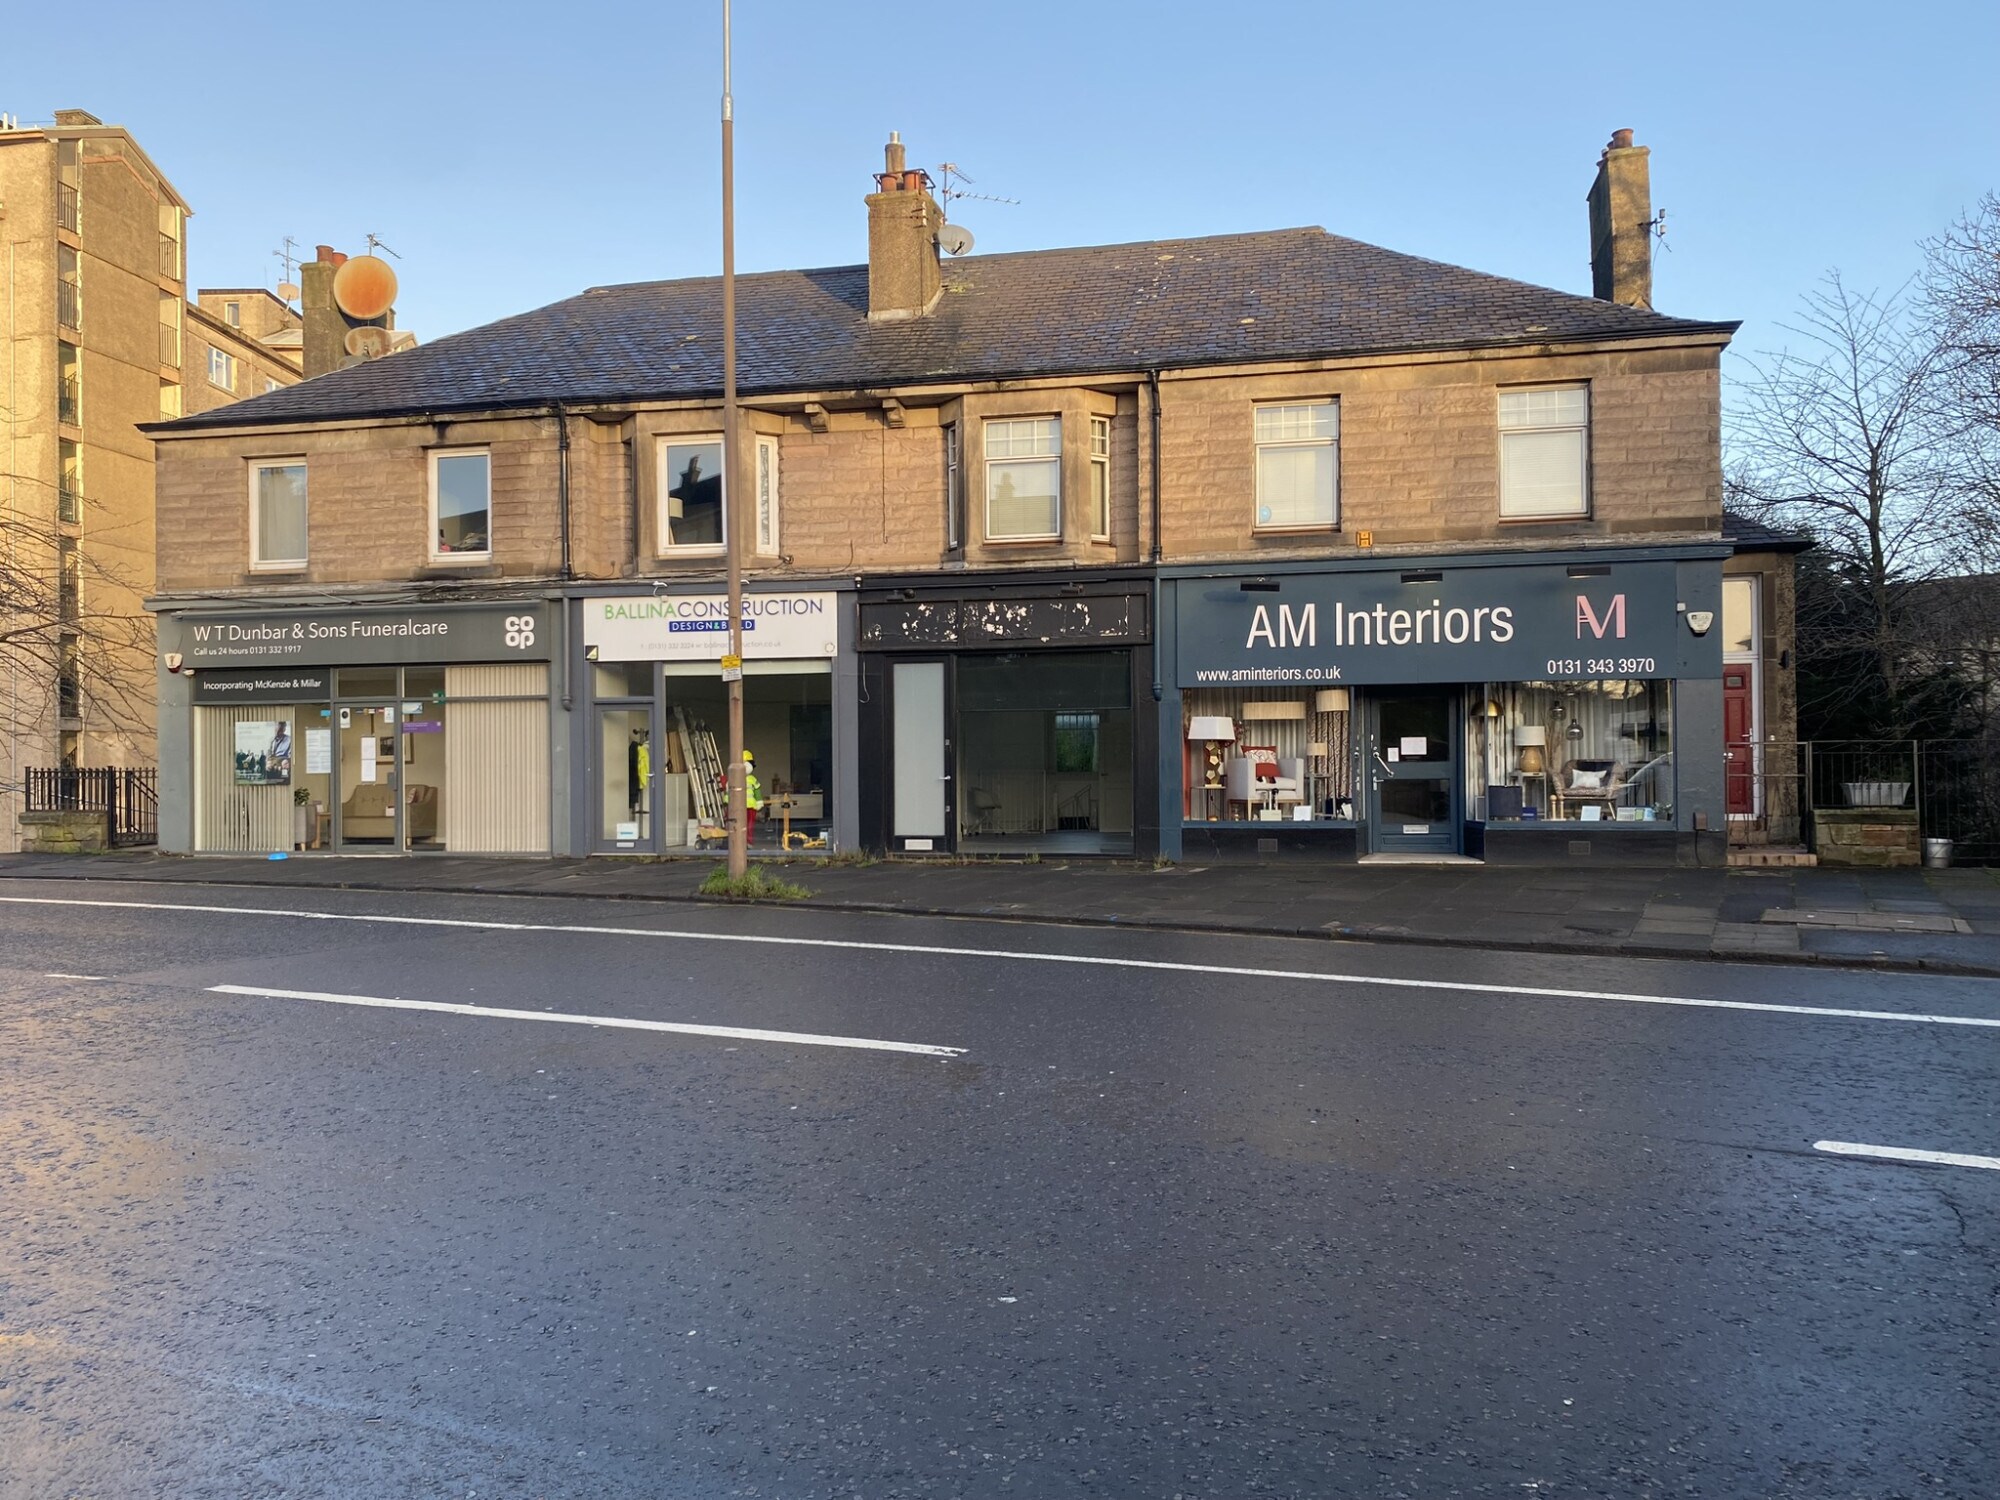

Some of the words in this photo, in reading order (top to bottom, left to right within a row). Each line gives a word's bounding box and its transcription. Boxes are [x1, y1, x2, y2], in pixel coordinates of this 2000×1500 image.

[604, 599, 823, 620] BALLINACONSRUCTION
[193, 625, 211, 642] W
[213, 625, 226, 641] T
[229, 624, 289, 641] Dunbar
[292, 622, 305, 639] &
[308, 622, 348, 638] Sons
[351, 618, 449, 637] Funeralcare
[671, 620, 753, 631] DESIGN&BD
[1246, 603, 1316, 649] AM
[1335, 599, 1514, 646] Interiors
[193, 647, 208, 656] Call
[218, 647, 228, 655] 24
[228, 646, 249, 655] hours
[249, 645, 267, 654] 0131
[269, 645, 283, 654] 332
[284, 644, 302, 653] 1917
[1196, 665, 1341, 682] www.aminteriors.co.uk
[1547, 659, 1581, 674] 0131
[1586, 659, 1614, 674] 343
[1618, 657, 1655, 673] 3970
[203, 681, 254, 691] Incorporating
[255, 679, 291, 689] McKenzie
[292, 679, 300, 688] &
